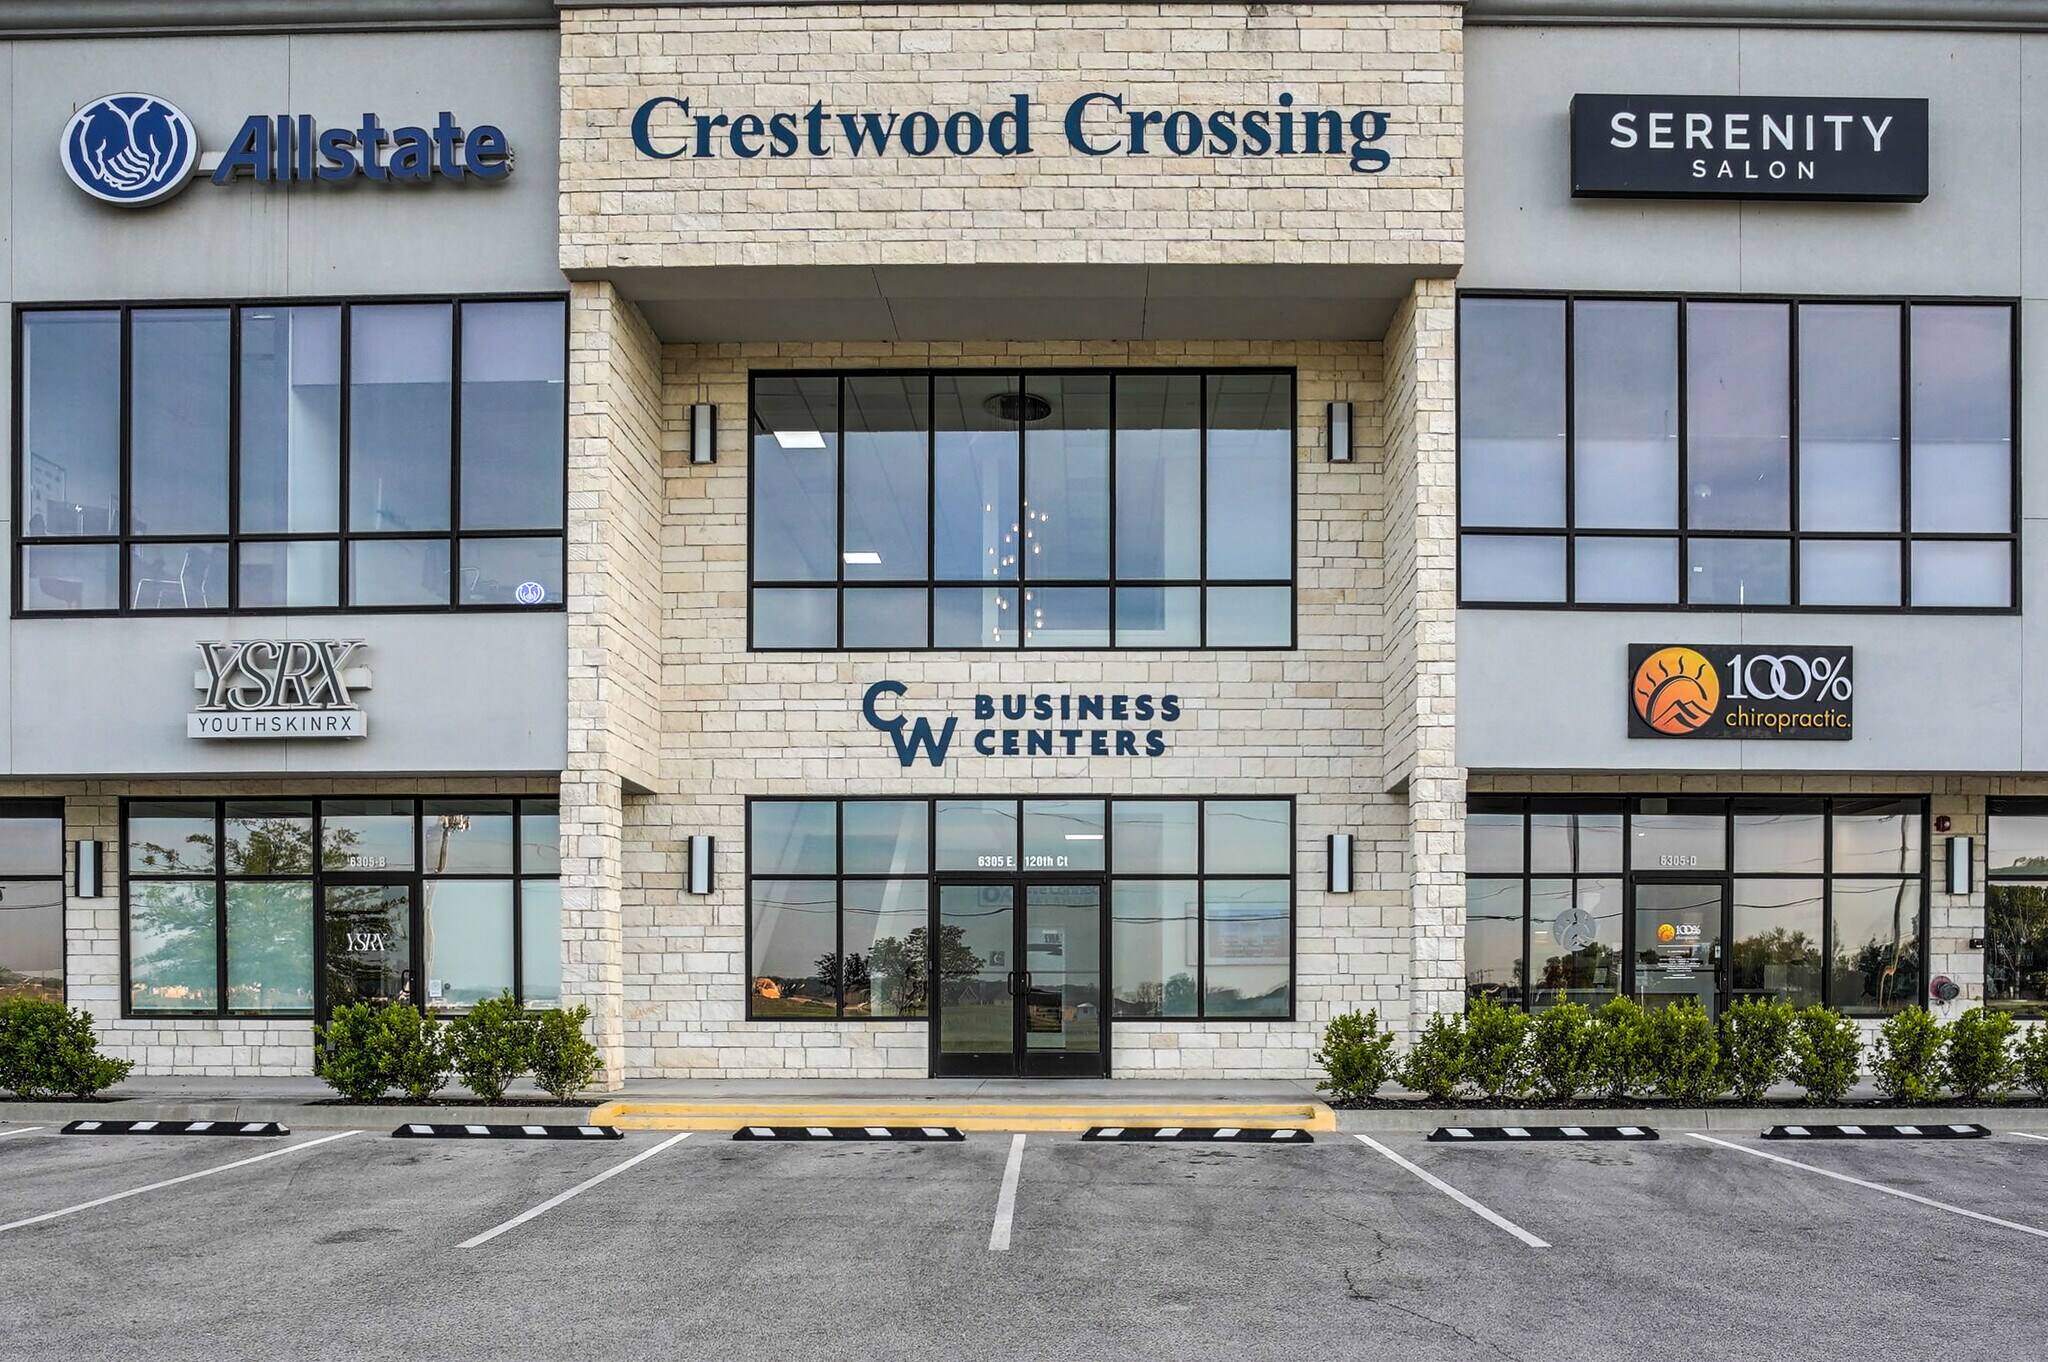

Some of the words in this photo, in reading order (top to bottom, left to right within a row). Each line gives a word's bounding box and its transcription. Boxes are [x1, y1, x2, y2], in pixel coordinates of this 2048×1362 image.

[631, 94, 1034, 159] Crestwood
[1064, 92, 1392, 173] Crossing
[1610, 111, 1893, 152] SERENITY
[210, 111, 509, 183] Allstate
[1692, 159, 1815, 180] SALON
[196, 640, 366, 711] YSRX
[1726, 654, 1852, 702] 100%
[974, 694, 1181, 721] BUSINESS
[198, 716, 352, 732] YOUTHSKINRX
[974, 729, 1166, 757] CENTERS
[350, 856, 386, 868] 6305-B
[978, 855, 1004, 867] 6305
[1006, 855, 1016, 867] E.
[1024, 855, 1054, 867] 120th
[1056, 855, 1069, 867] Ct
[347, 933, 387, 951] YSRX
